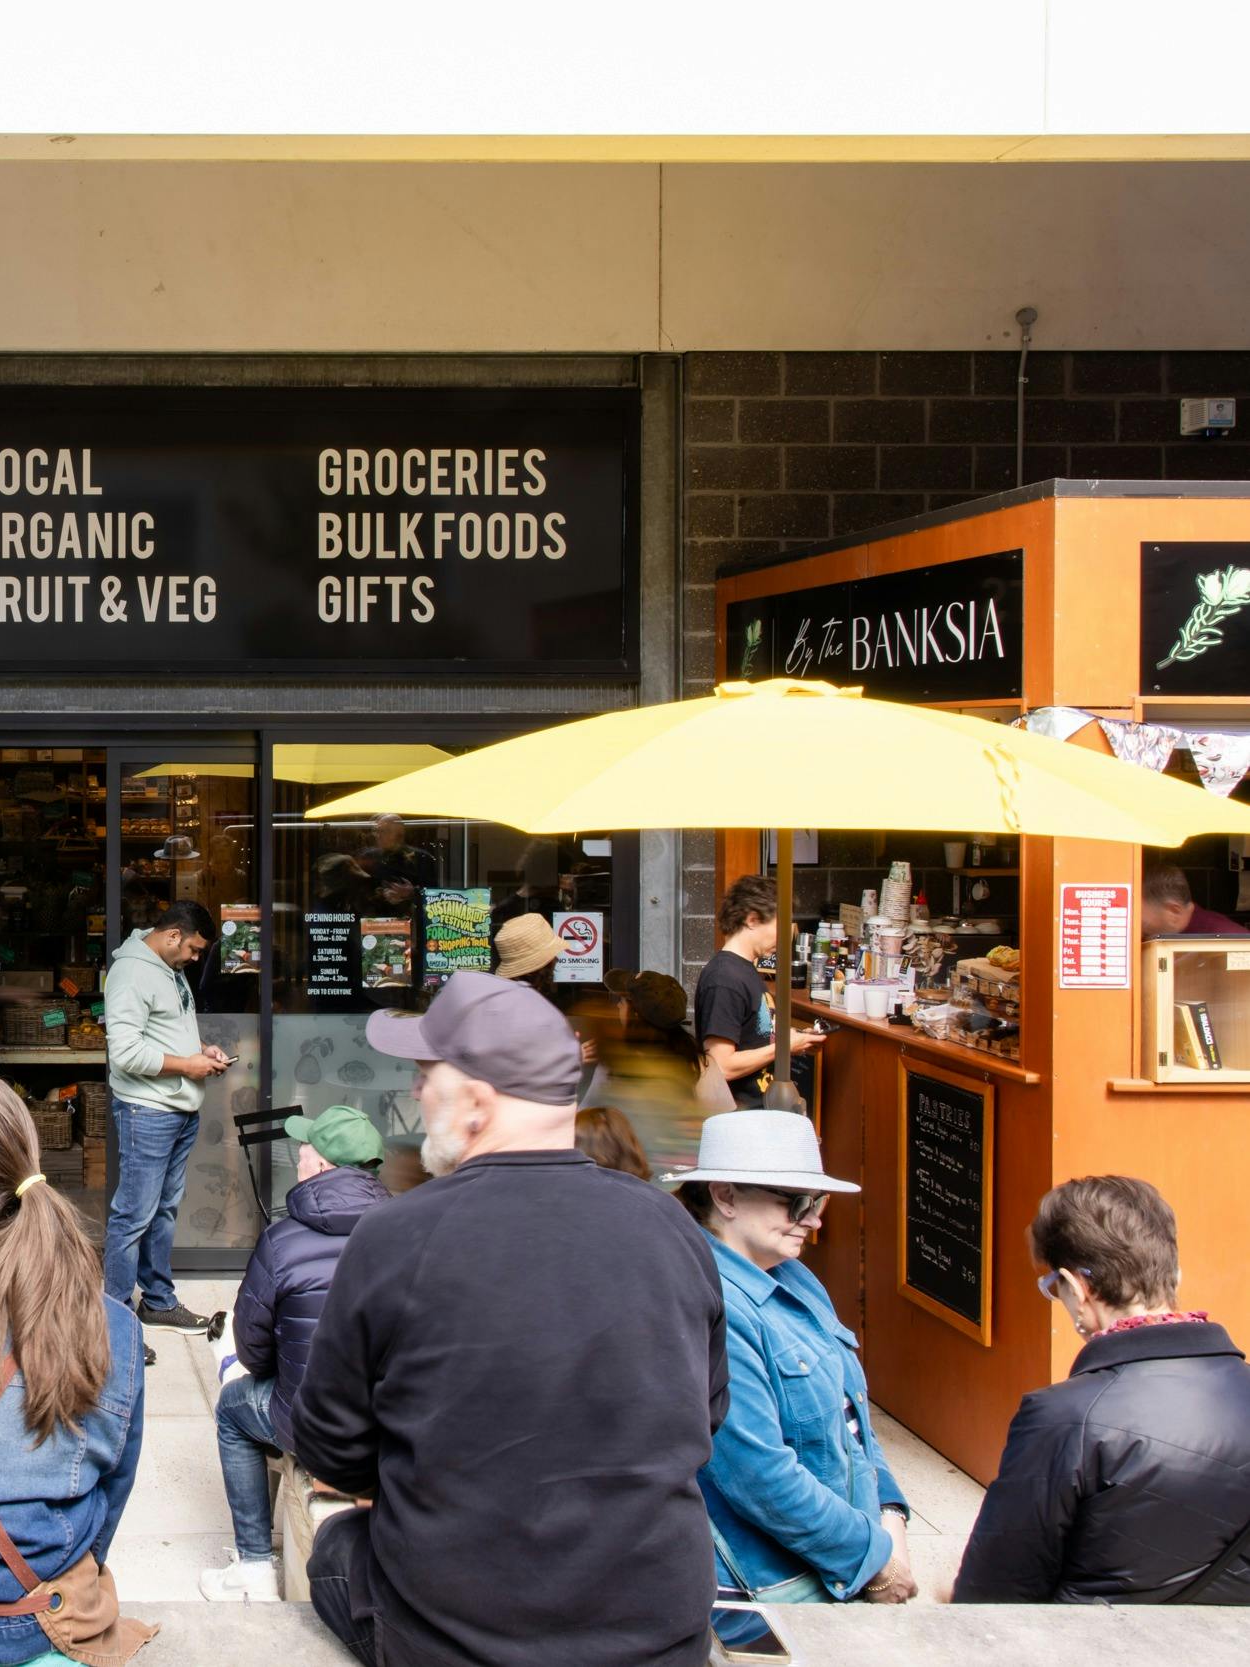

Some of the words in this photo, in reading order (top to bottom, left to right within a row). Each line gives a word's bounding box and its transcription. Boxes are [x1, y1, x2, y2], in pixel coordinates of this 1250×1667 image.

[318, 448, 547, 496] GROCERIES
[318, 512, 425, 560] BULK
[434, 512, 567, 560] FOODS
[99, 575, 128, 623] &
[137, 575, 217, 623] VEG
[318, 575, 435, 623] GIFTS
[785, 617, 814, 678] By
[851, 597, 1005, 671] BANKSIA
[1075, 890, 1117, 899] BUSINESS
[304, 913, 333, 922] OPENING
[334, 913, 356, 922] HOURS
[425, 901, 486, 923] SUSTAINABILITY
[440, 915, 476, 933] FESTIVAL
[438, 937, 471, 951] SHOPPING
[471, 937, 491, 948] TRAIL
[444, 946, 491, 958] WORKSHOPS
[448, 955, 491, 966] MARKETS
[918, 1093, 972, 1129] PASTRIES
